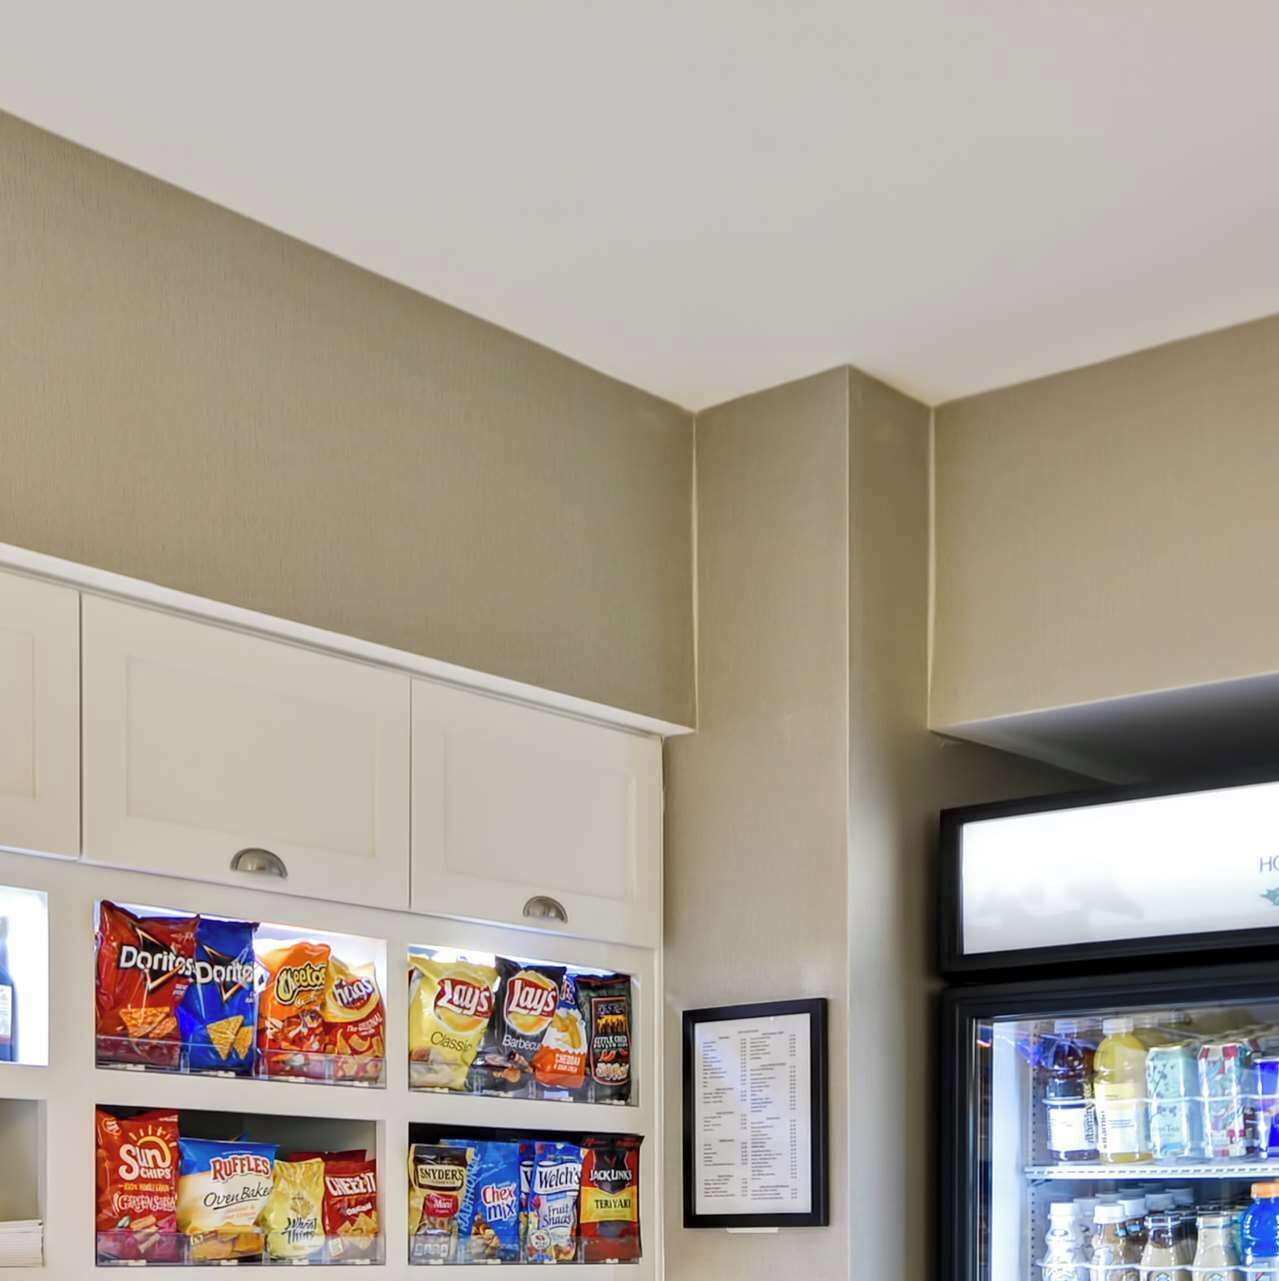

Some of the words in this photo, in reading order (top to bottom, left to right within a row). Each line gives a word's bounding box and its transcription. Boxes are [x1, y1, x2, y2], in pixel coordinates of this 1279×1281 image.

[119, 945, 194, 977] Doritos
[436, 980, 492, 1016] Lay's
[506, 980, 558, 1016] Lay's
[119, 1143, 171, 1181] Sun
[210, 1155, 270, 1181] RUFFLES
[139, 1167, 171, 1179] CHIPS
[420, 1167, 464, 1181] SNYDER'S
[538, 1166, 580, 1189] Welch's
[589, 1169, 611, 1180] JACK
[612, 1169, 632, 1180] LINK'S
[204, 1190, 240, 1208] Oven
[482, 1183, 516, 1204] Chex
[487, 1202, 516, 1222] mix
[547, 1205, 569, 1217] Fruit
[595, 1198, 632, 1210] TERIYAKI
[285, 1217, 318, 1231] Wheat
[542, 1214, 570, 1228] Snacks
[282, 1229, 315, 1243] Thins
